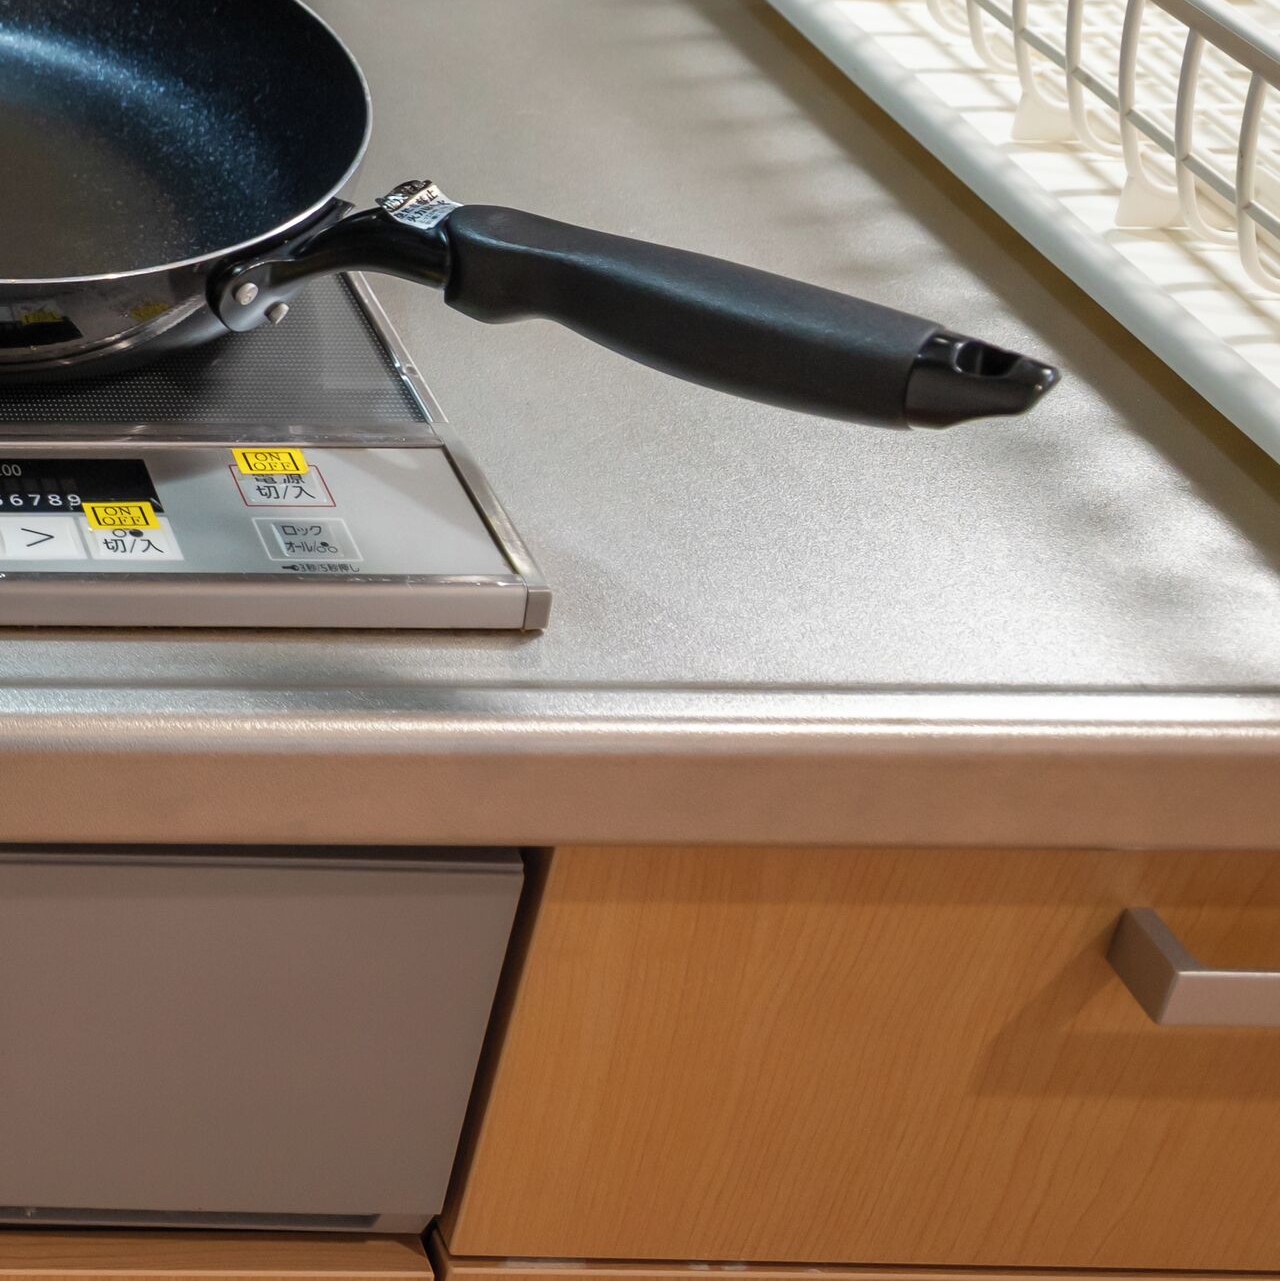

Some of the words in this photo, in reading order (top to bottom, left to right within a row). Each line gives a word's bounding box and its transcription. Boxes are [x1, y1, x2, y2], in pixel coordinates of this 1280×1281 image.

[254, 452, 281, 461] ON
[253, 461, 292, 471] OFF
[255, 485, 316, 499] 切/入
[103, 507, 131, 516] ON
[102, 516, 142, 526] OFF
[281, 525, 322, 536] ロック
[103, 538, 165, 553] 切/入
